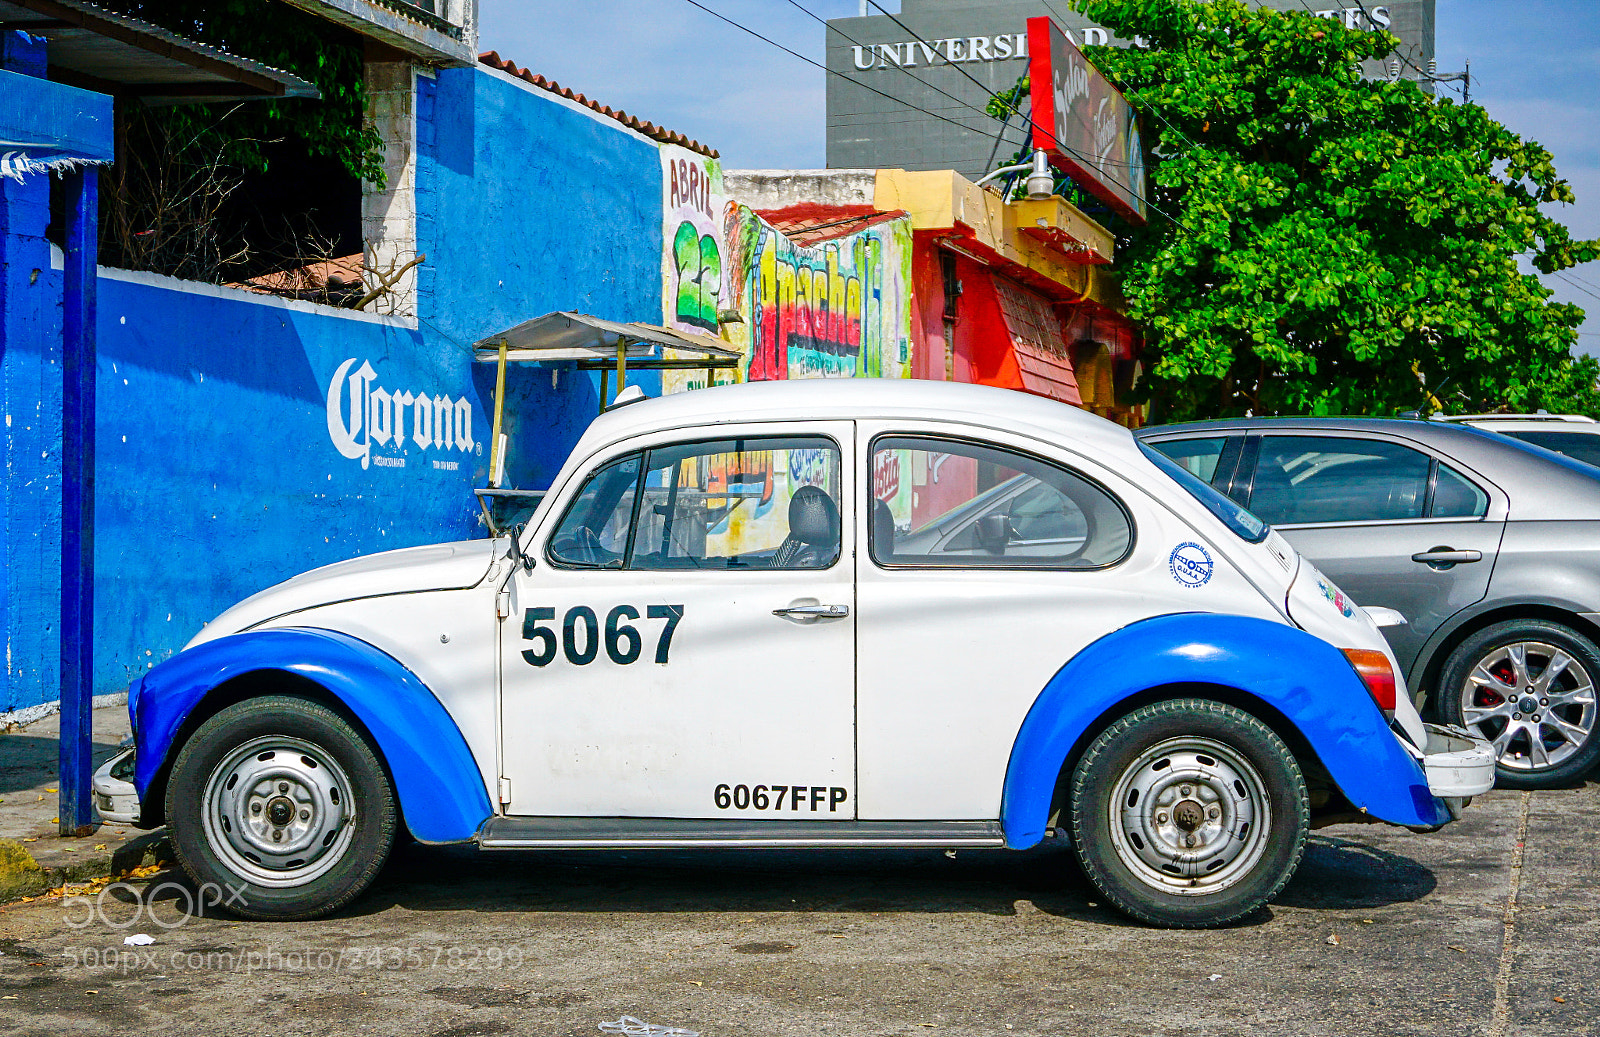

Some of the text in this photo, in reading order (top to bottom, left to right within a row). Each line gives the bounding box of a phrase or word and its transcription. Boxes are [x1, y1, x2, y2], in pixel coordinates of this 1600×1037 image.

[670, 157, 714, 222] ABRIL
[326, 356, 475, 471] Corona
[520, 603, 685, 667] 5067
[714, 783, 848, 812] 6067FFP
